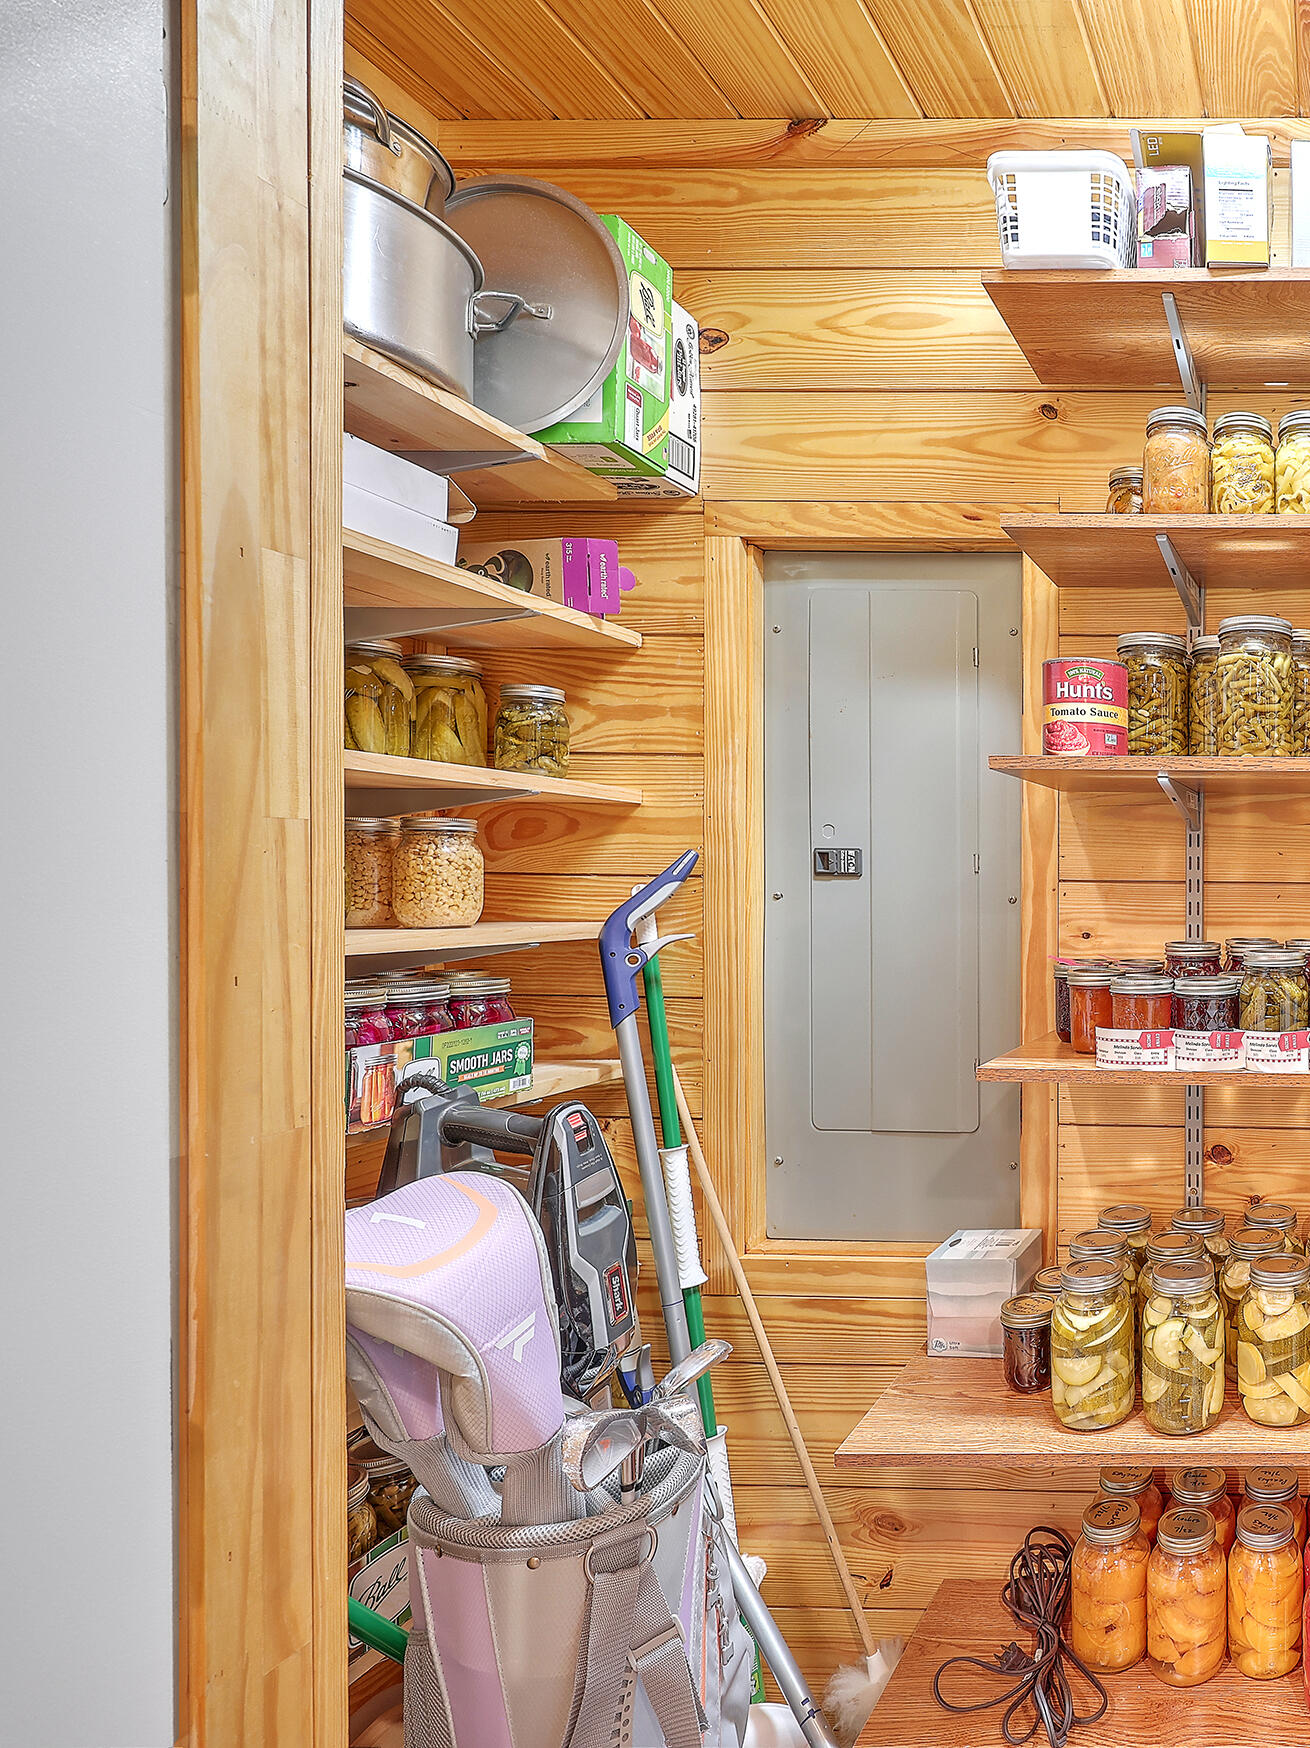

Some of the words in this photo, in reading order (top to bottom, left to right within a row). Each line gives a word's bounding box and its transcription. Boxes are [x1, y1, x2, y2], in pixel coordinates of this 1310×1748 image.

[1147, 136, 1160, 157] LED
[600, 580, 608, 598] rated
[1056, 680, 1115, 702] Hunt's
[1050, 707, 1087, 717] Tomato
[1089, 707, 1119, 720] Sauce
[449, 1053, 489, 1075] SMOOTH
[490, 1048, 514, 1067] JARS
[611, 1275, 623, 1311] Shark
